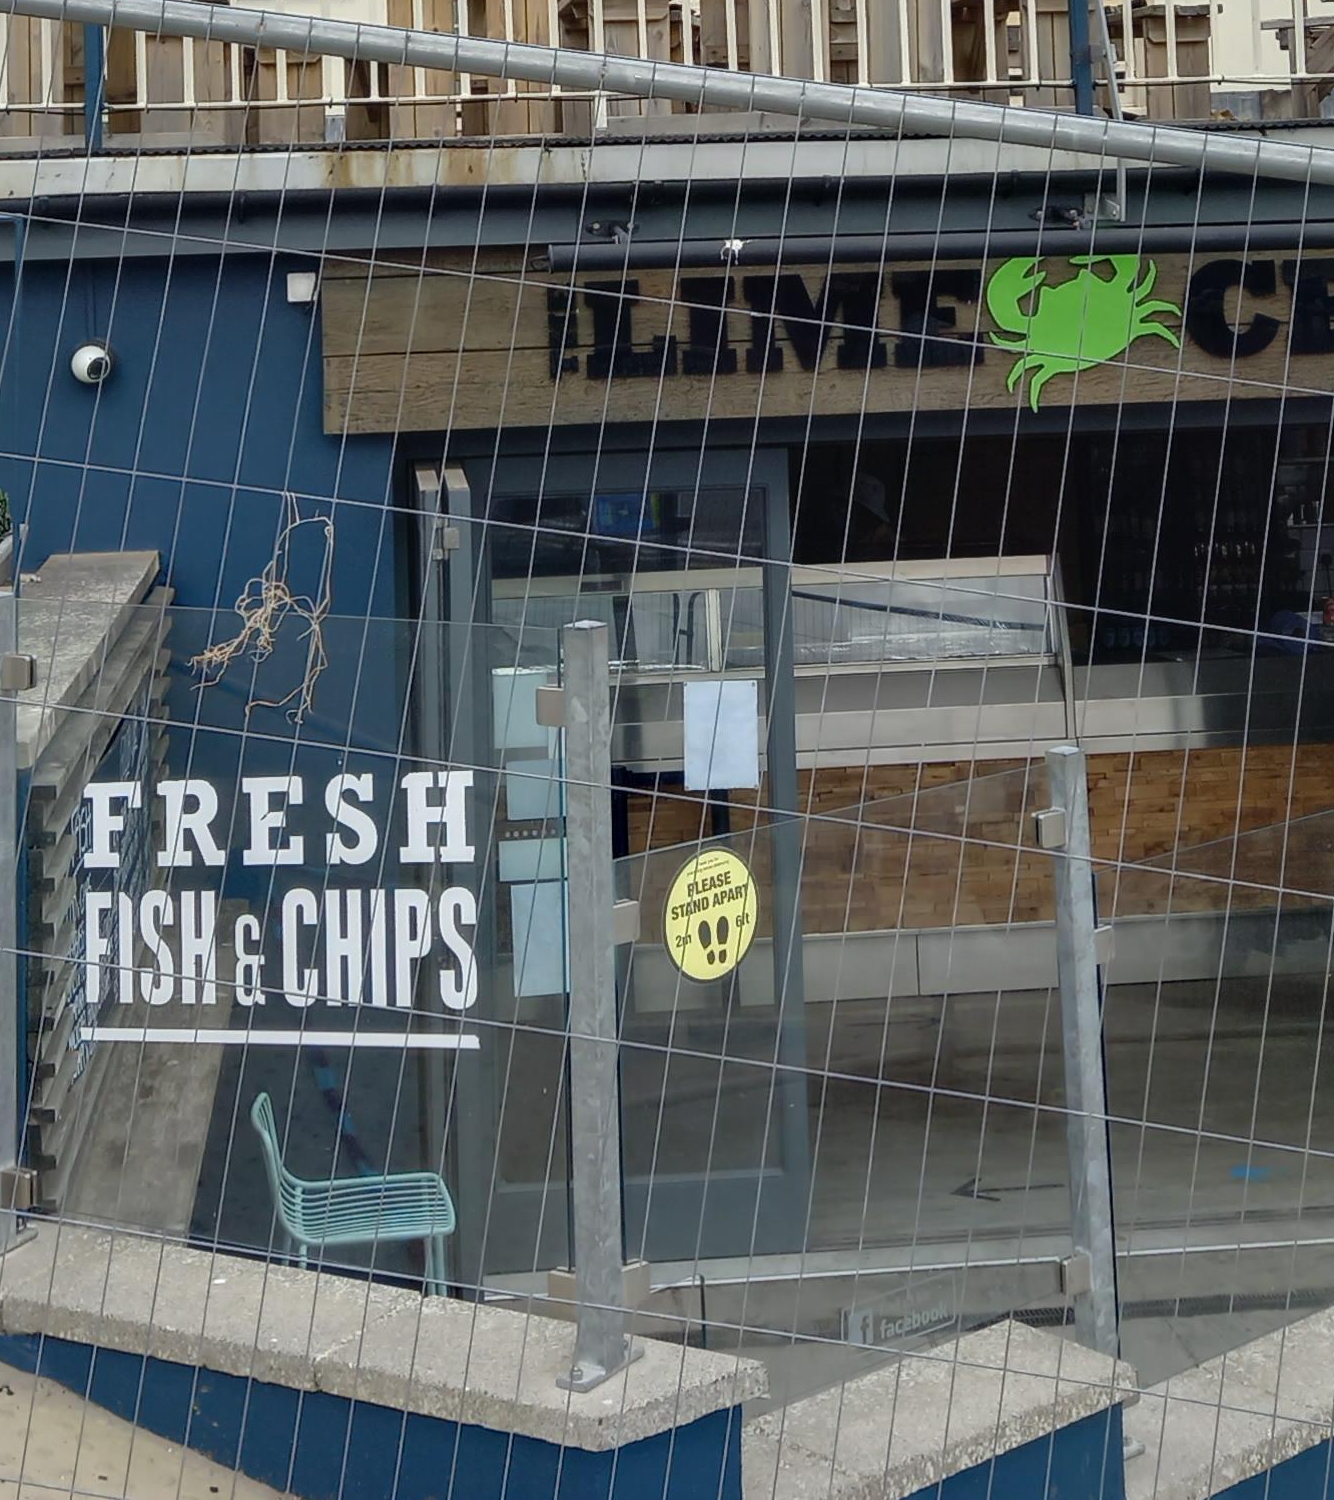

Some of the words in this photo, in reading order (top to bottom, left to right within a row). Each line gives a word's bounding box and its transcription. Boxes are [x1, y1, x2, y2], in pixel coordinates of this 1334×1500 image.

[585, 269, 985, 379] LIME
[83, 770, 475, 868] FRESH
[671, 897, 709, 921] STAND
[713, 883, 748, 908] APART
[687, 871, 731, 897] PLEASE
[735, 912, 750, 928] 6ft
[85, 889, 217, 1006] FISH
[235, 914, 265, 1006] &
[282, 886, 478, 1010] CHIPS
[675, 932, 692, 949] 2m
